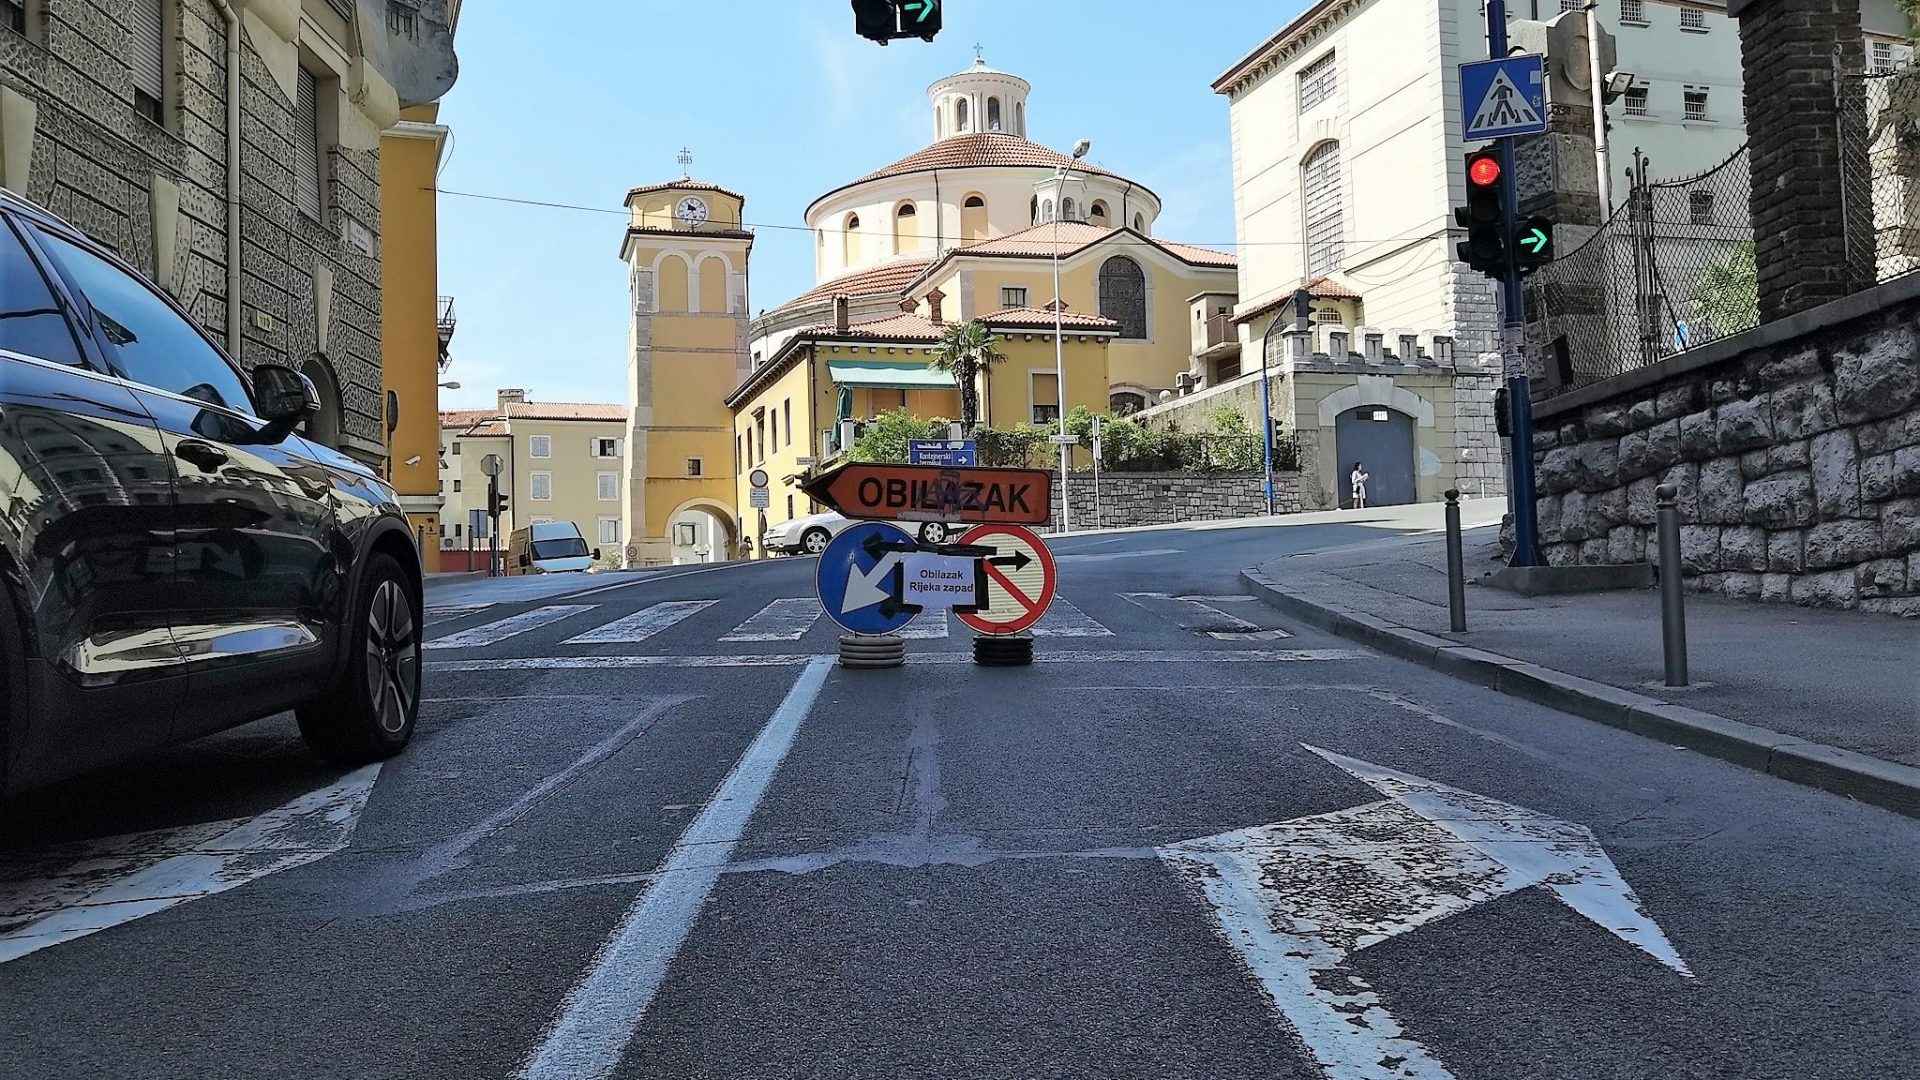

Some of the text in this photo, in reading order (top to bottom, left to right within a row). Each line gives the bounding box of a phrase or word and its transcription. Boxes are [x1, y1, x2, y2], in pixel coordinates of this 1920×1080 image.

[919, 452, 951, 461] Kontejnerski
[858, 477, 1031, 514] OBILAZAK
[920, 569, 964, 580] Obilazak
[909, 581, 974, 595] Rijeka zapad
